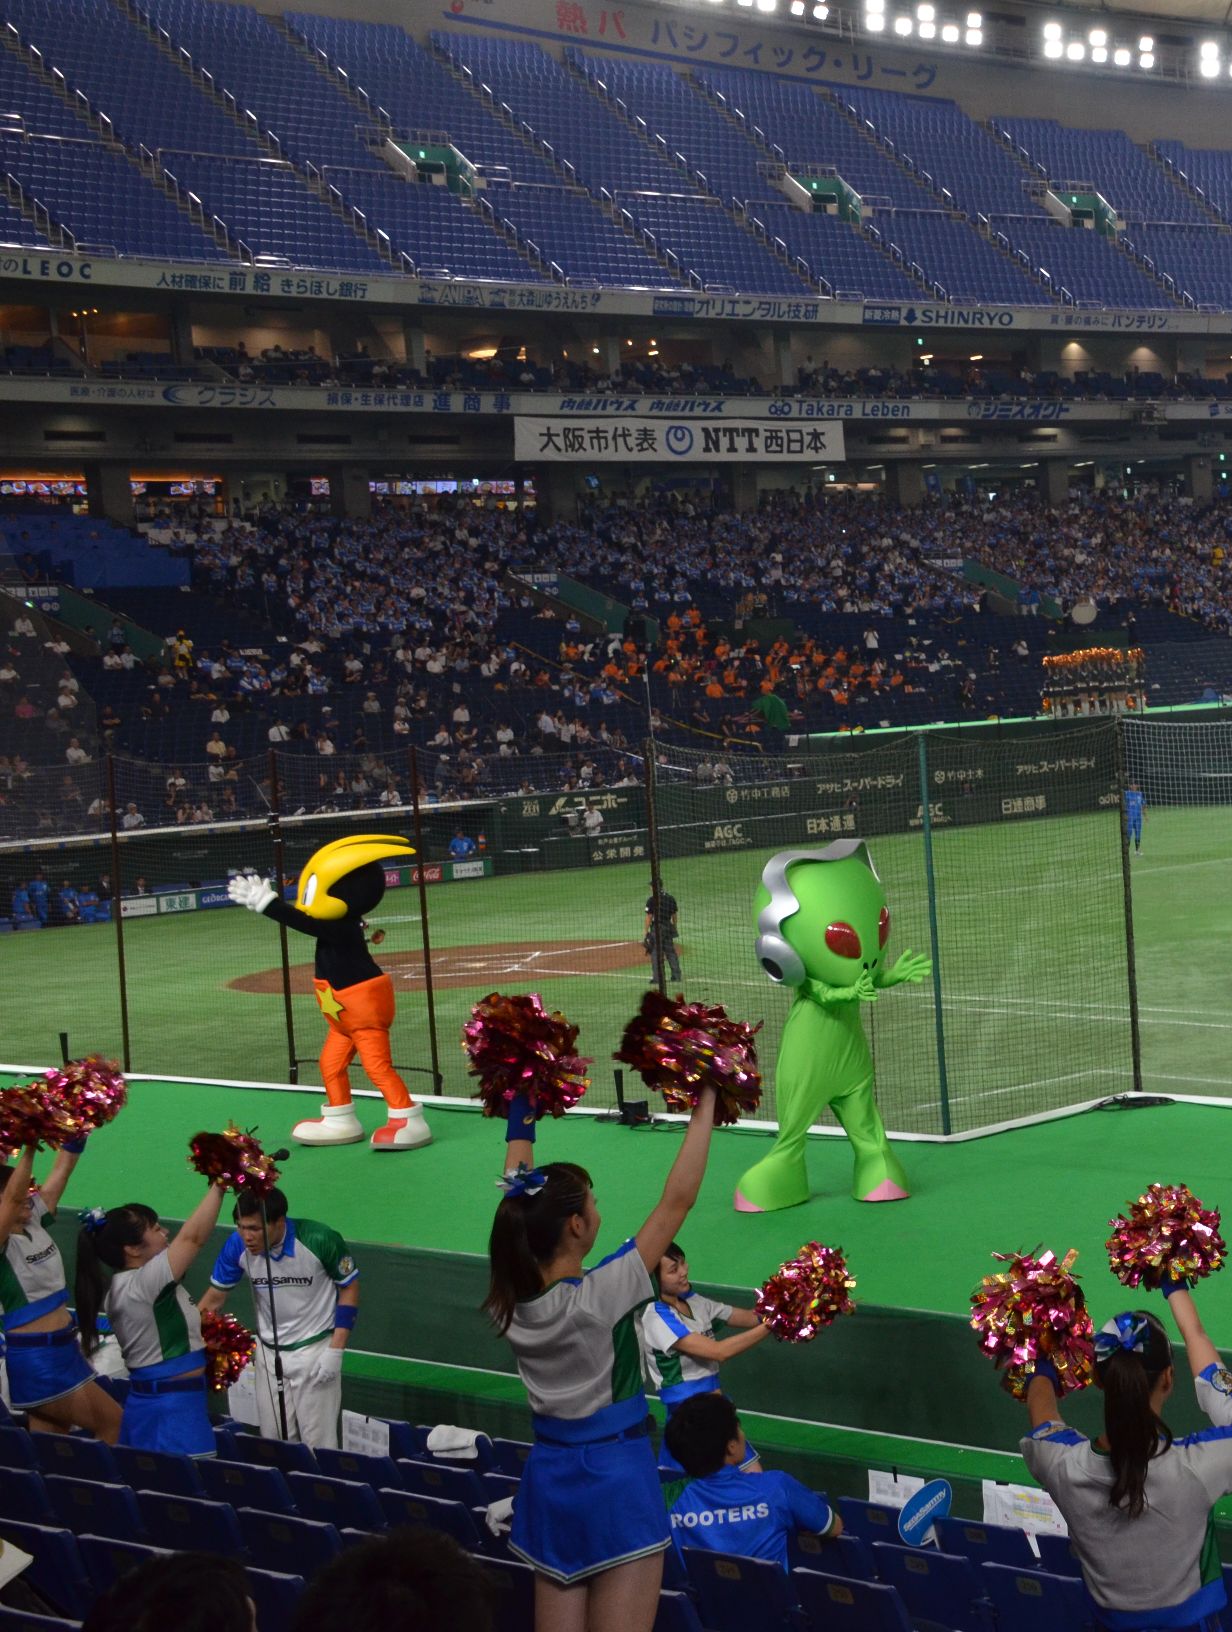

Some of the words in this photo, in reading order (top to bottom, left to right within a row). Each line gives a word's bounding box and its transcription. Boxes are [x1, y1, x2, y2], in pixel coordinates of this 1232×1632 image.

[651, 18, 938, 89] パシフィック・リーグ
[22, 258, 91, 280] LEOC
[156, 271, 224, 290] 人材確保に
[280, 278, 368, 299] きらぼし銀行
[696, 299, 819, 321] オリエンタル技研
[920, 309, 1013, 326] SHINRYO
[1111, 315, 1168, 328] バンテリン
[796, 400, 853, 416] Takara
[861, 401, 911, 417] Leben
[539, 427, 657, 454] 大阪市代表
[701, 427, 826, 454] NTT西日本
[1016, 757, 1096, 775] アサヒスーパードライ
[817, 774, 904, 794] アサヒスーパードライ
[714, 824, 743, 839] AGC
[670, 1503, 769, 1529] ROOTERS
